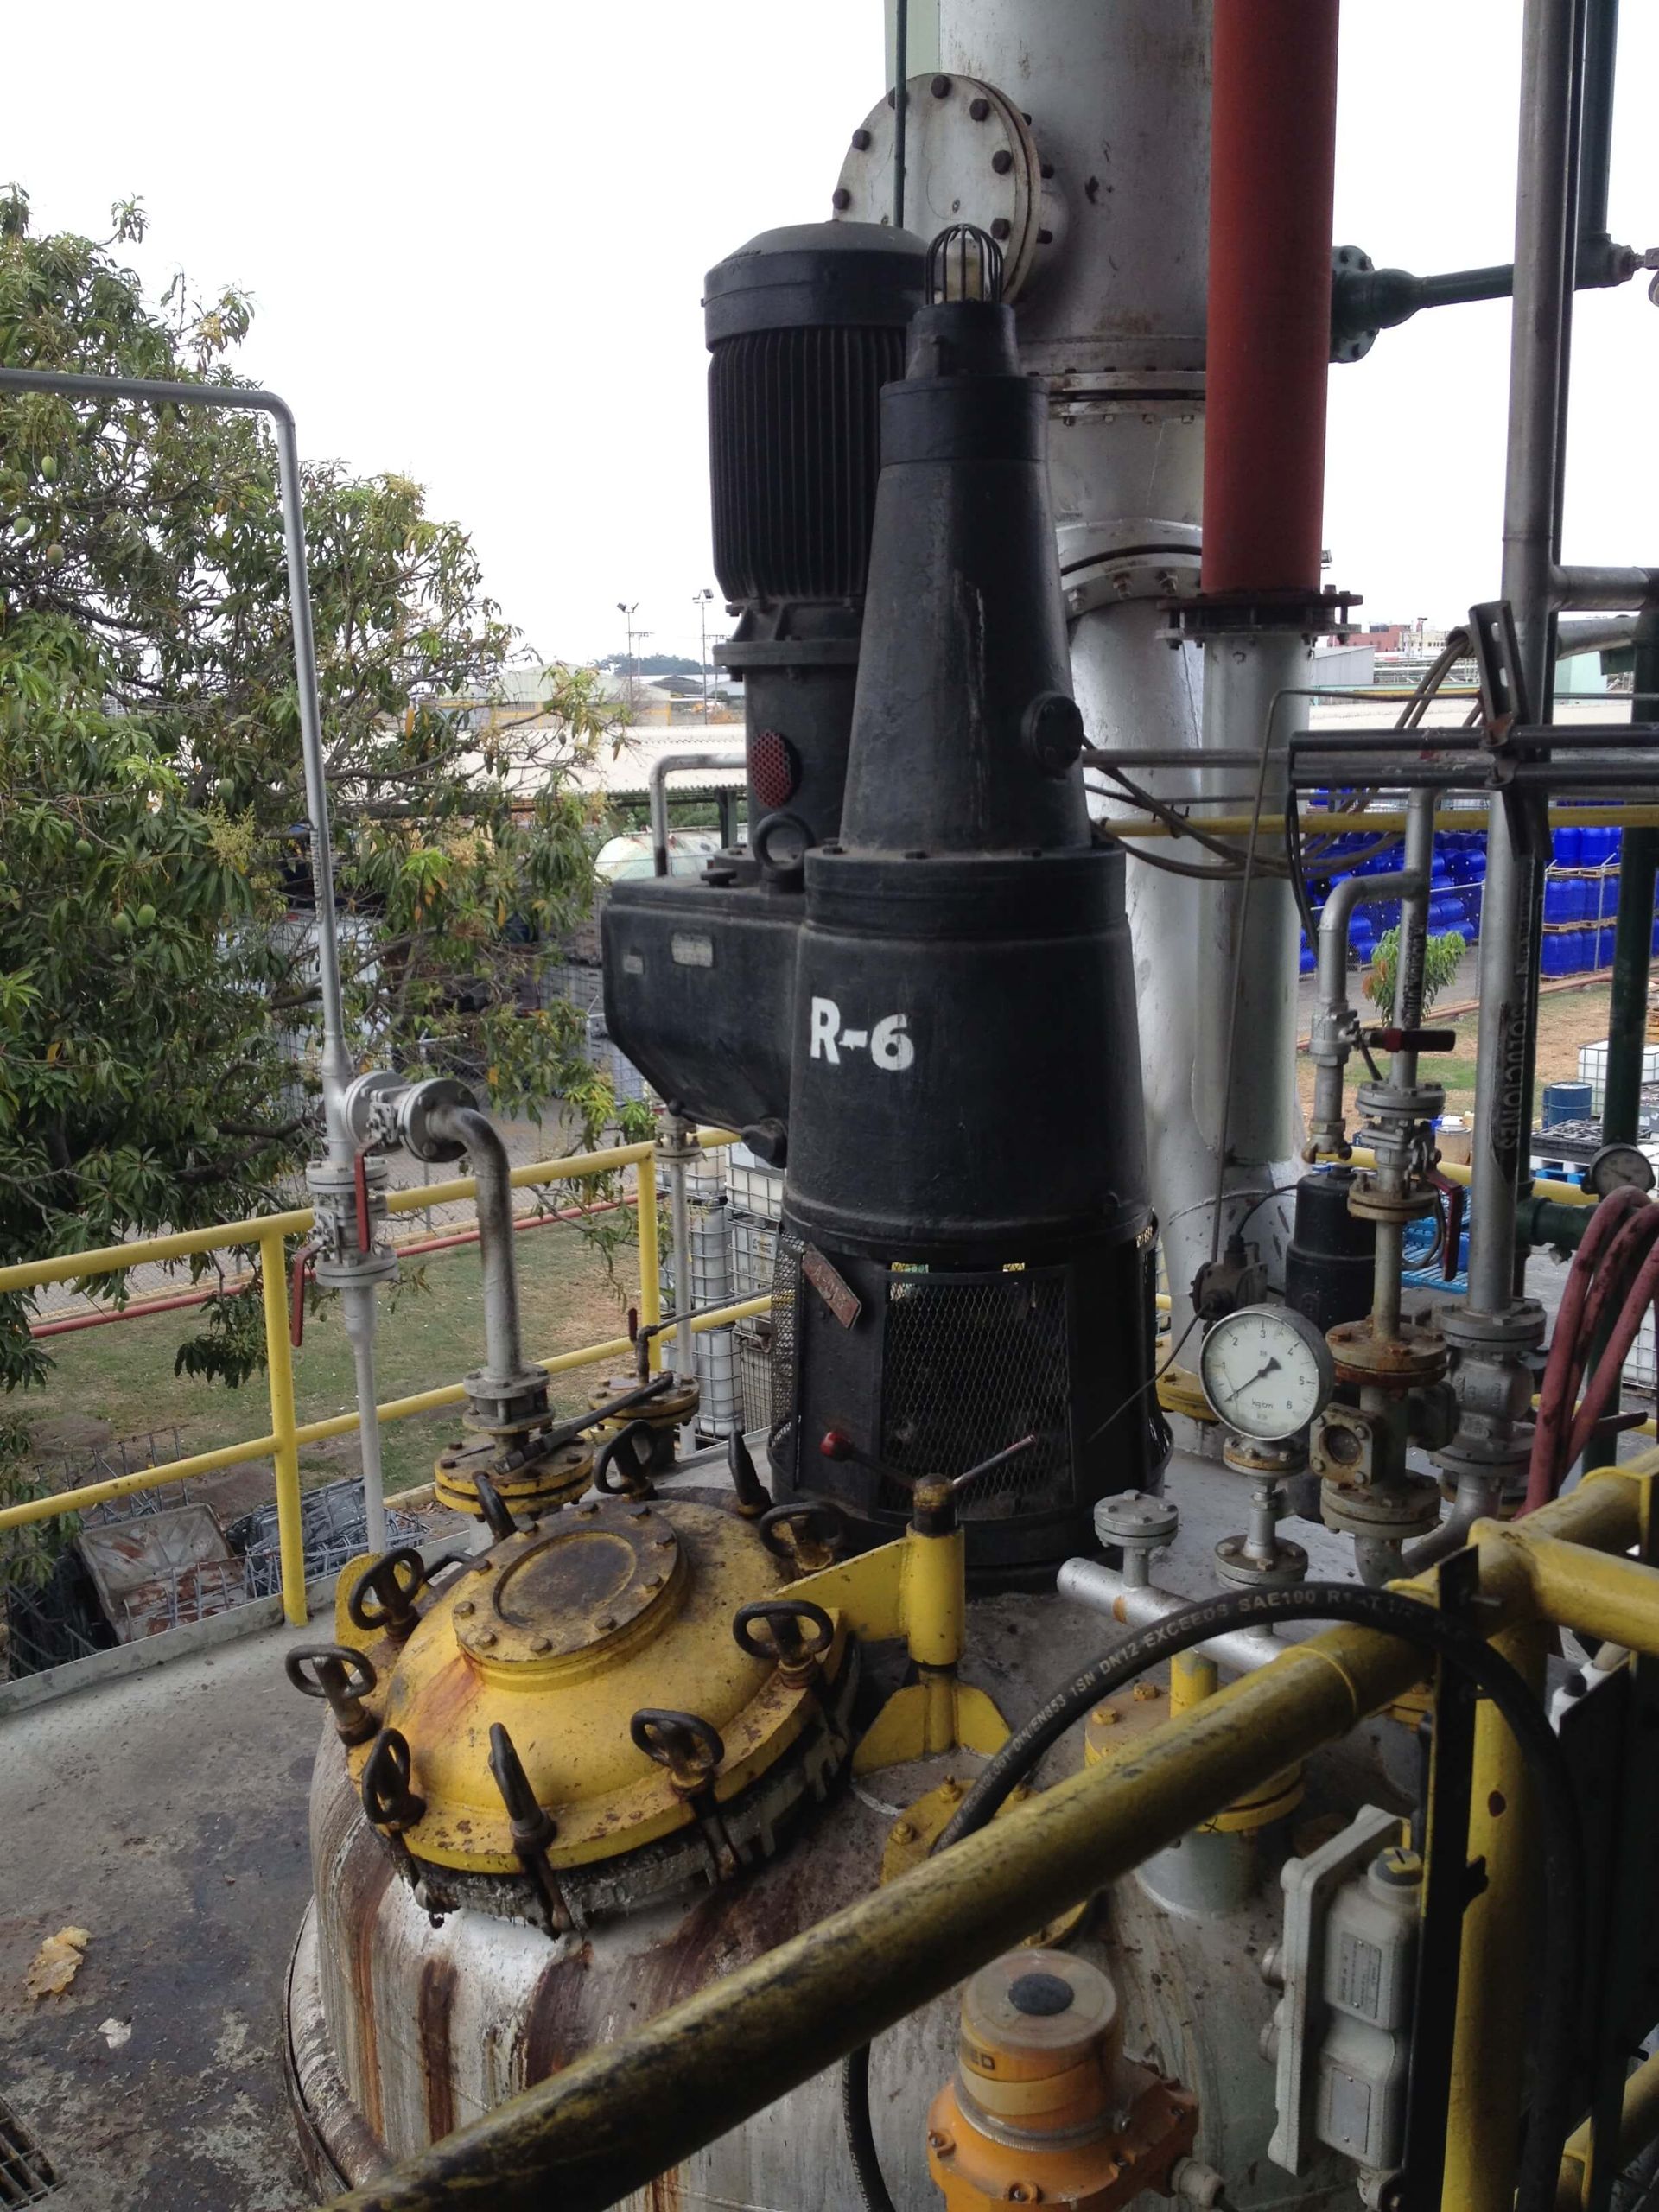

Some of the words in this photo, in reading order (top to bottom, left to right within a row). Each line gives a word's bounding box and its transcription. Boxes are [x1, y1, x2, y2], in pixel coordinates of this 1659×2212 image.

[810, 996, 914, 1071] R-6
[1261, 1330, 1266, 1338] 3
[1232, 1338, 1238, 1346] 2
[1299, 1376, 1305, 1385] 5
[1287, 1400, 1293, 1409] 6
[1099, 1643, 1139, 1675] DN12
[1144, 1604, 1229, 1648] EXCEEDS
[1239, 1590, 1315, 1611] SAE100
